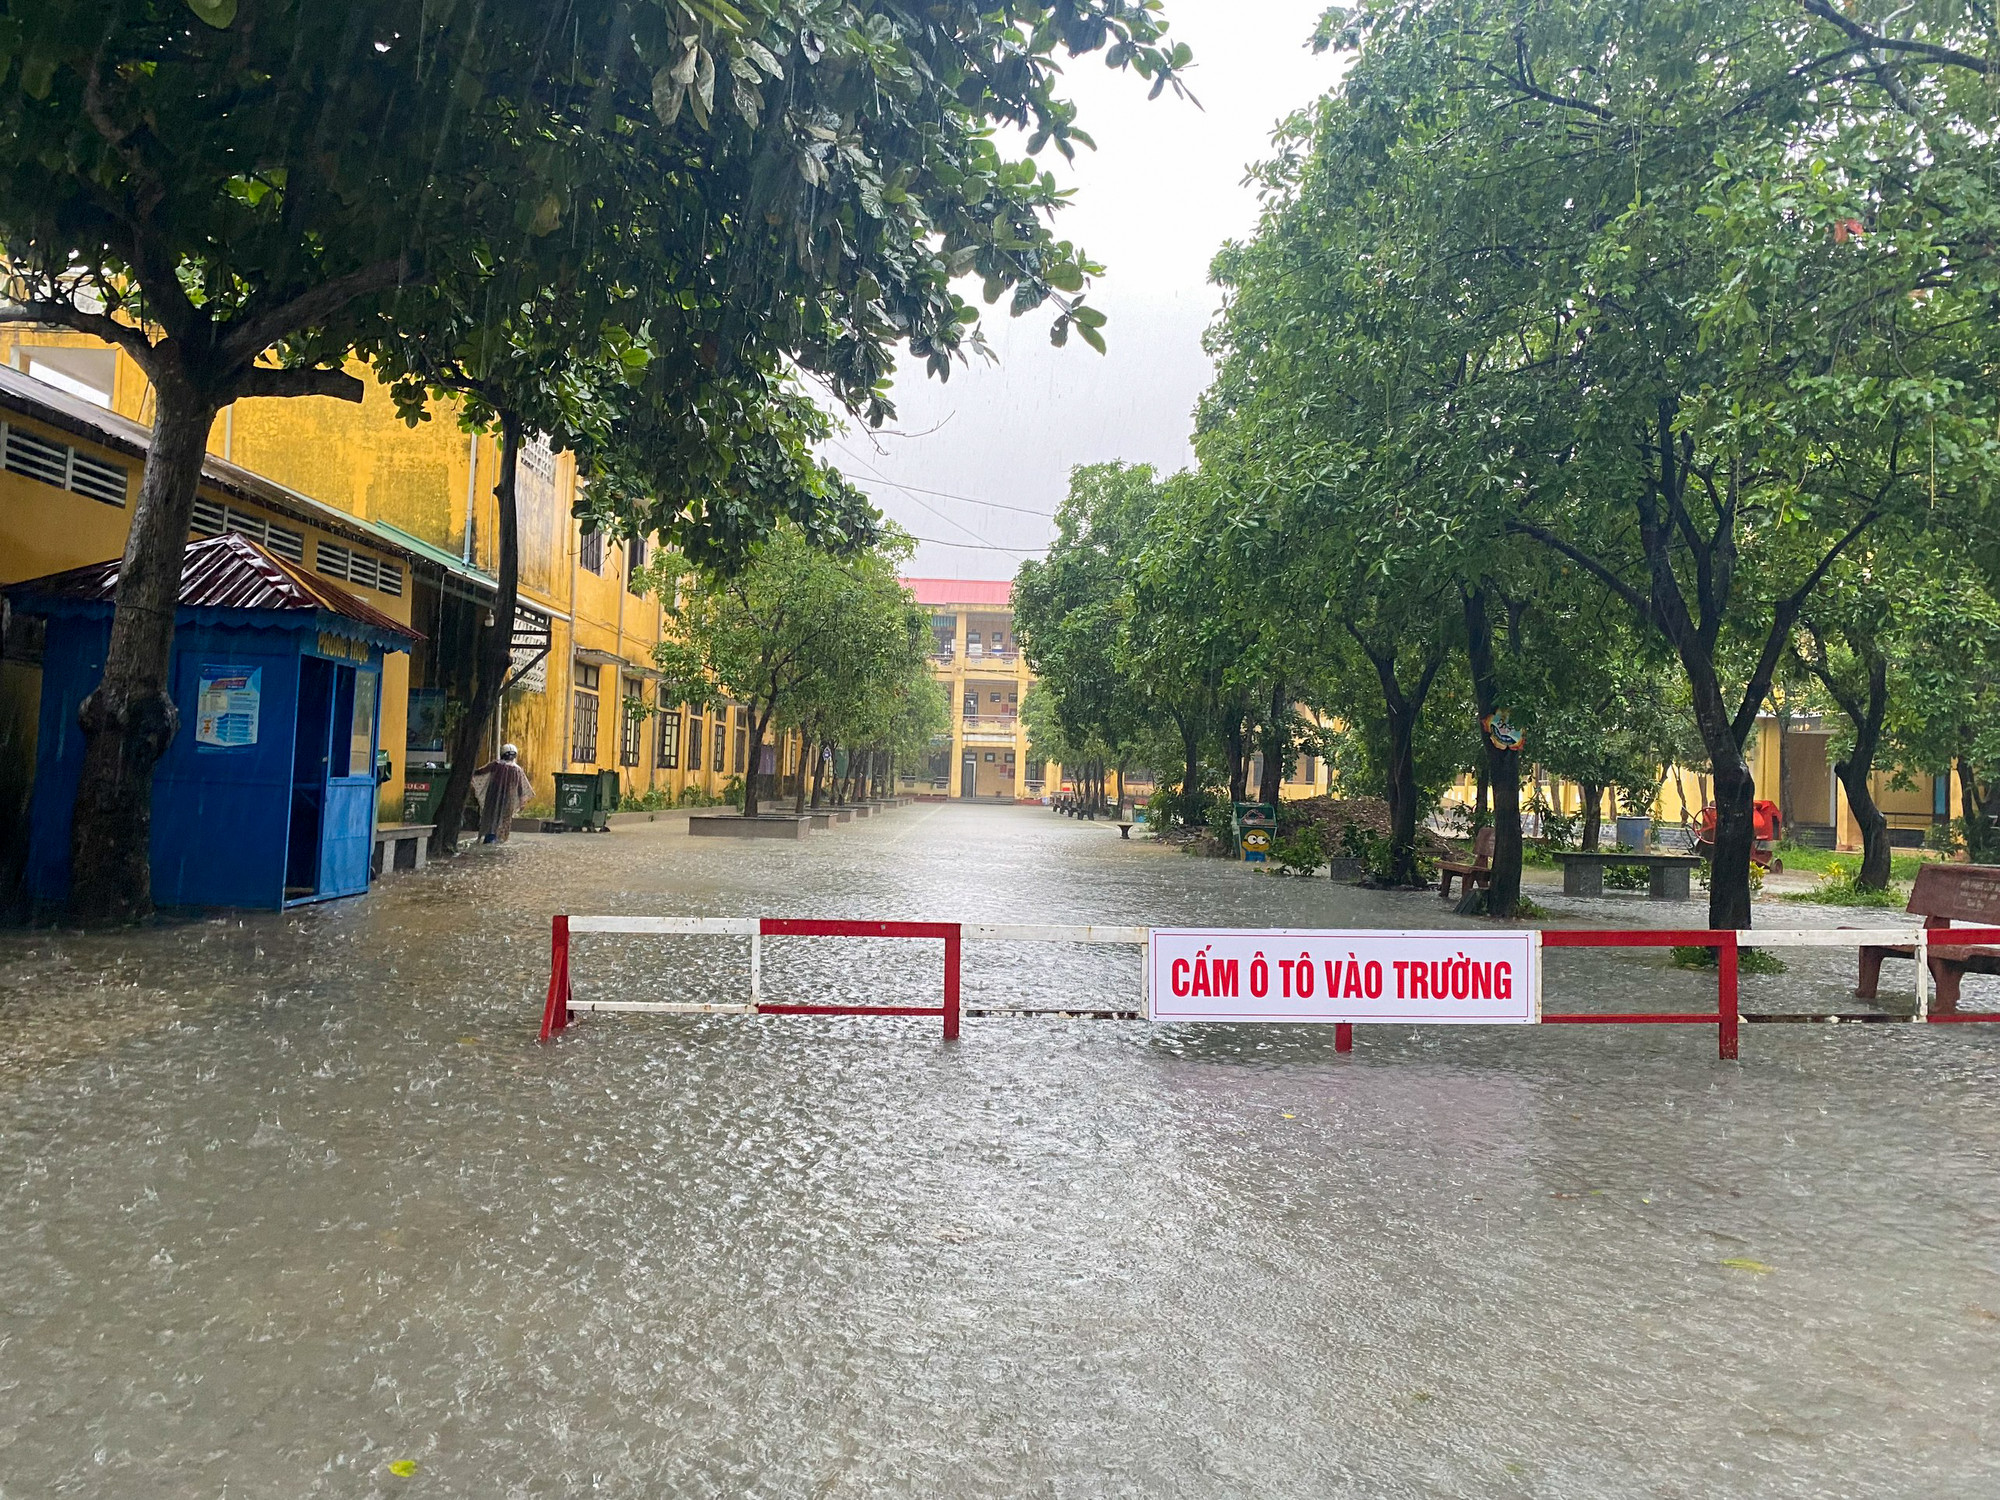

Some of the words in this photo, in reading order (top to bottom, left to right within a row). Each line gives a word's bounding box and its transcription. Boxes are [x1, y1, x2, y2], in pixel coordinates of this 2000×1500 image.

[1171, 944, 1239, 998] CẤM
[1250, 951, 1269, 998] Ô
[1278, 951, 1315, 999] TÔ
[1325, 952, 1383, 999] VÀO
[1393, 951, 1512, 1000] TRƯỜNG
